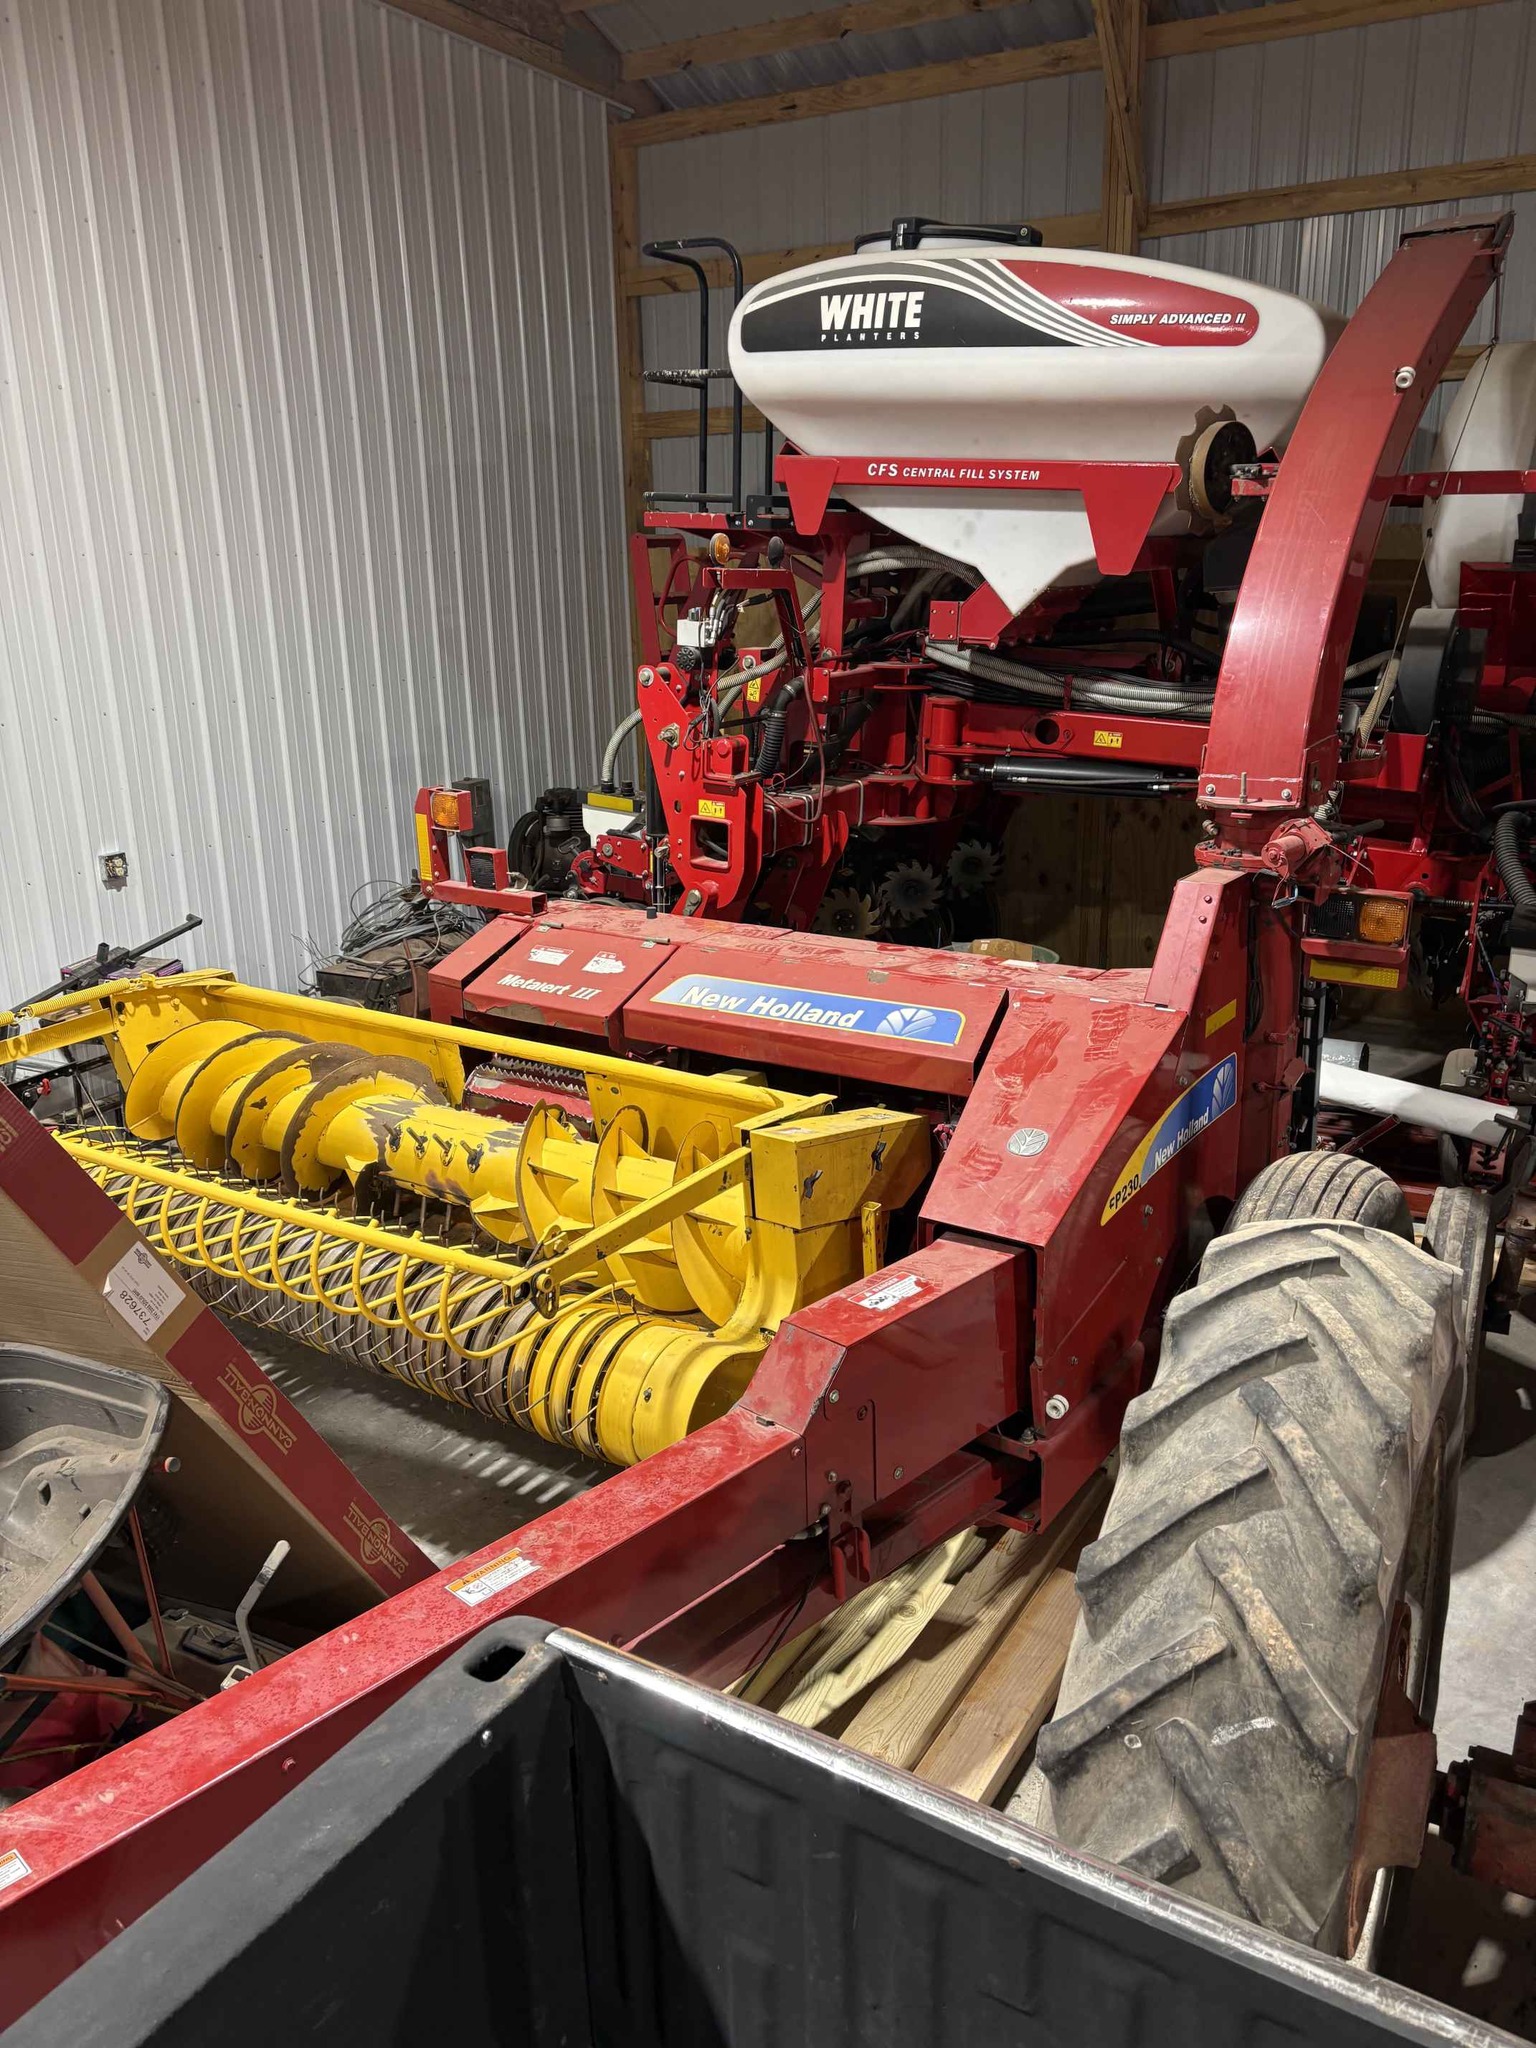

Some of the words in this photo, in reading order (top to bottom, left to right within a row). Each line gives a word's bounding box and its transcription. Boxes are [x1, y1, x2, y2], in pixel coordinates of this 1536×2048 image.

[820, 291, 925, 331] WHITE
[1110, 314, 1157, 325] SIMPLY
[1158, 313, 1231, 324] ADVANCED
[1235, 313, 1247, 324] II
[820, 331, 920, 343] PLANTERS
[867, 463, 898, 477] CFS
[902, 467, 956, 479] CENTRAL
[959, 468, 985, 479] FILL
[988, 469, 1041, 481] SYSTEM
[497, 973, 572, 995] Metalert
[568, 986, 602, 1000] III
[680, 986, 746, 1011] New
[746, 995, 865, 1028] Holland
[1154, 1139, 1176, 1170] New
[1176, 1106, 1209, 1149] Holland
[119, 1290, 151, 1326] 737628
[224, 1366, 294, 1449] CANNONBALL
[348, 1506, 406, 1574] CANNONBALL
[471, 1556, 512, 1579] WARNING
